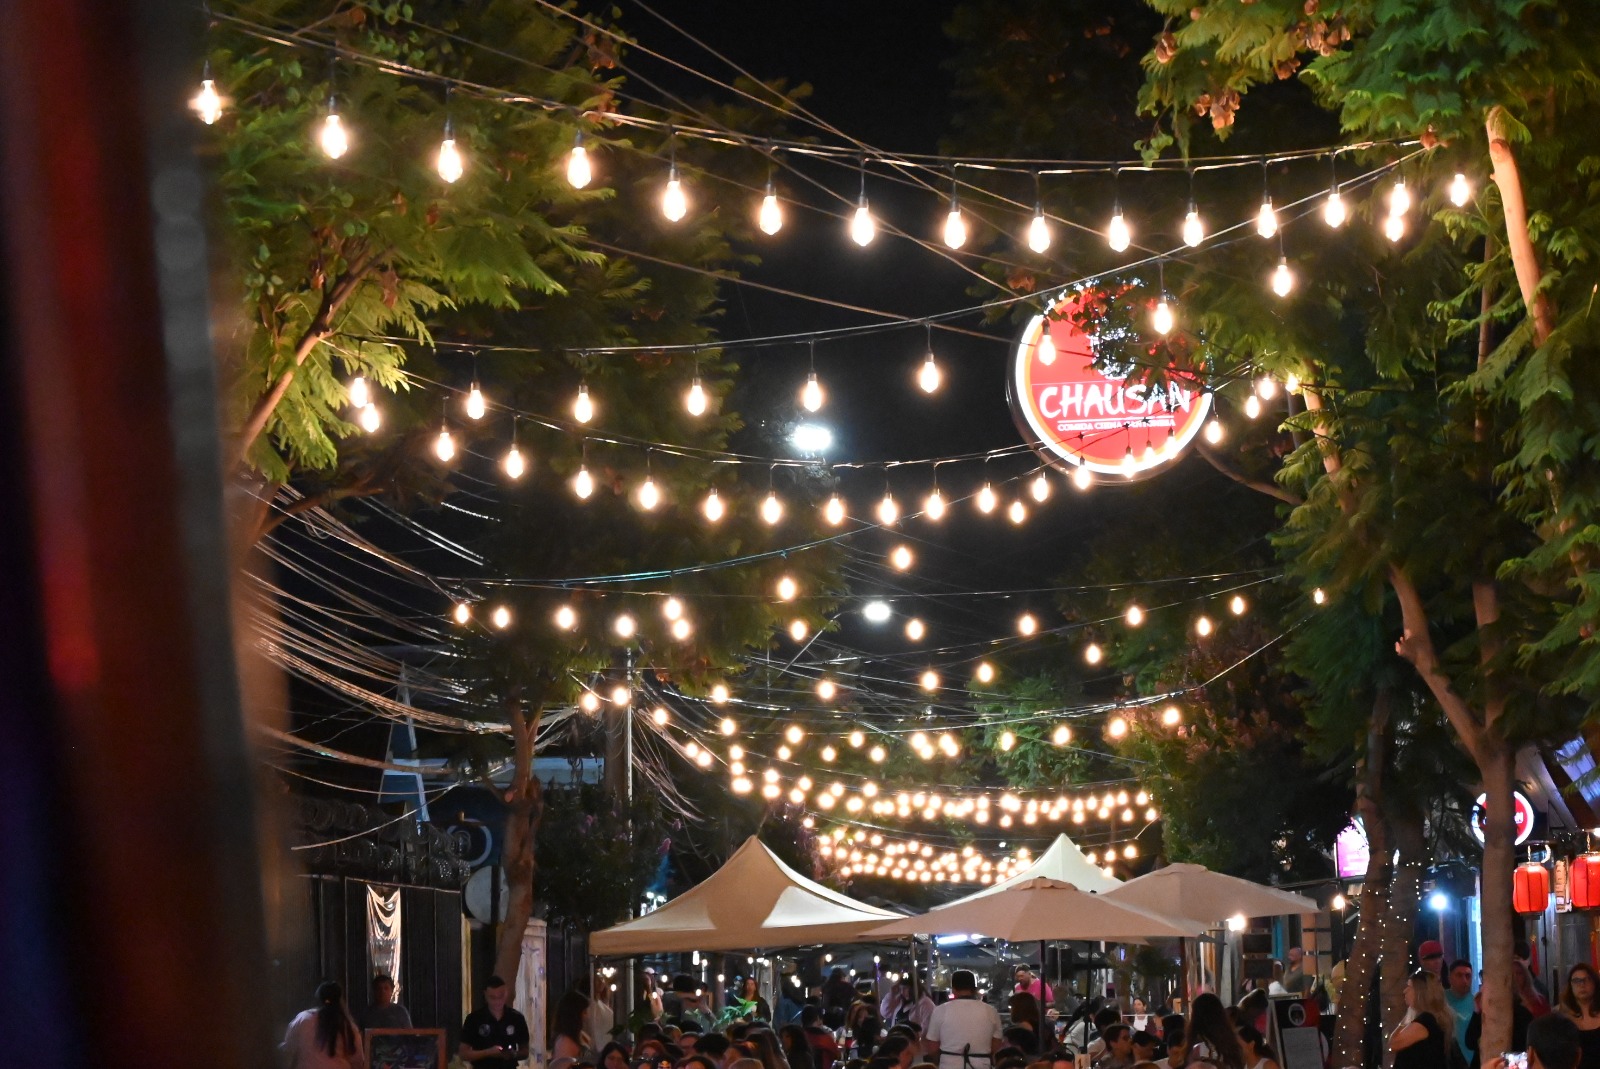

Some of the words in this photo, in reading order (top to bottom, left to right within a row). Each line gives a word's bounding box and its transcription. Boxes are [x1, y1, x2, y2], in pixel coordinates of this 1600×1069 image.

[1039, 381, 1190, 418] CHAUSAN
[1058, 423, 1093, 431] COMIDA
[1094, 421, 1122, 430] CHINA
